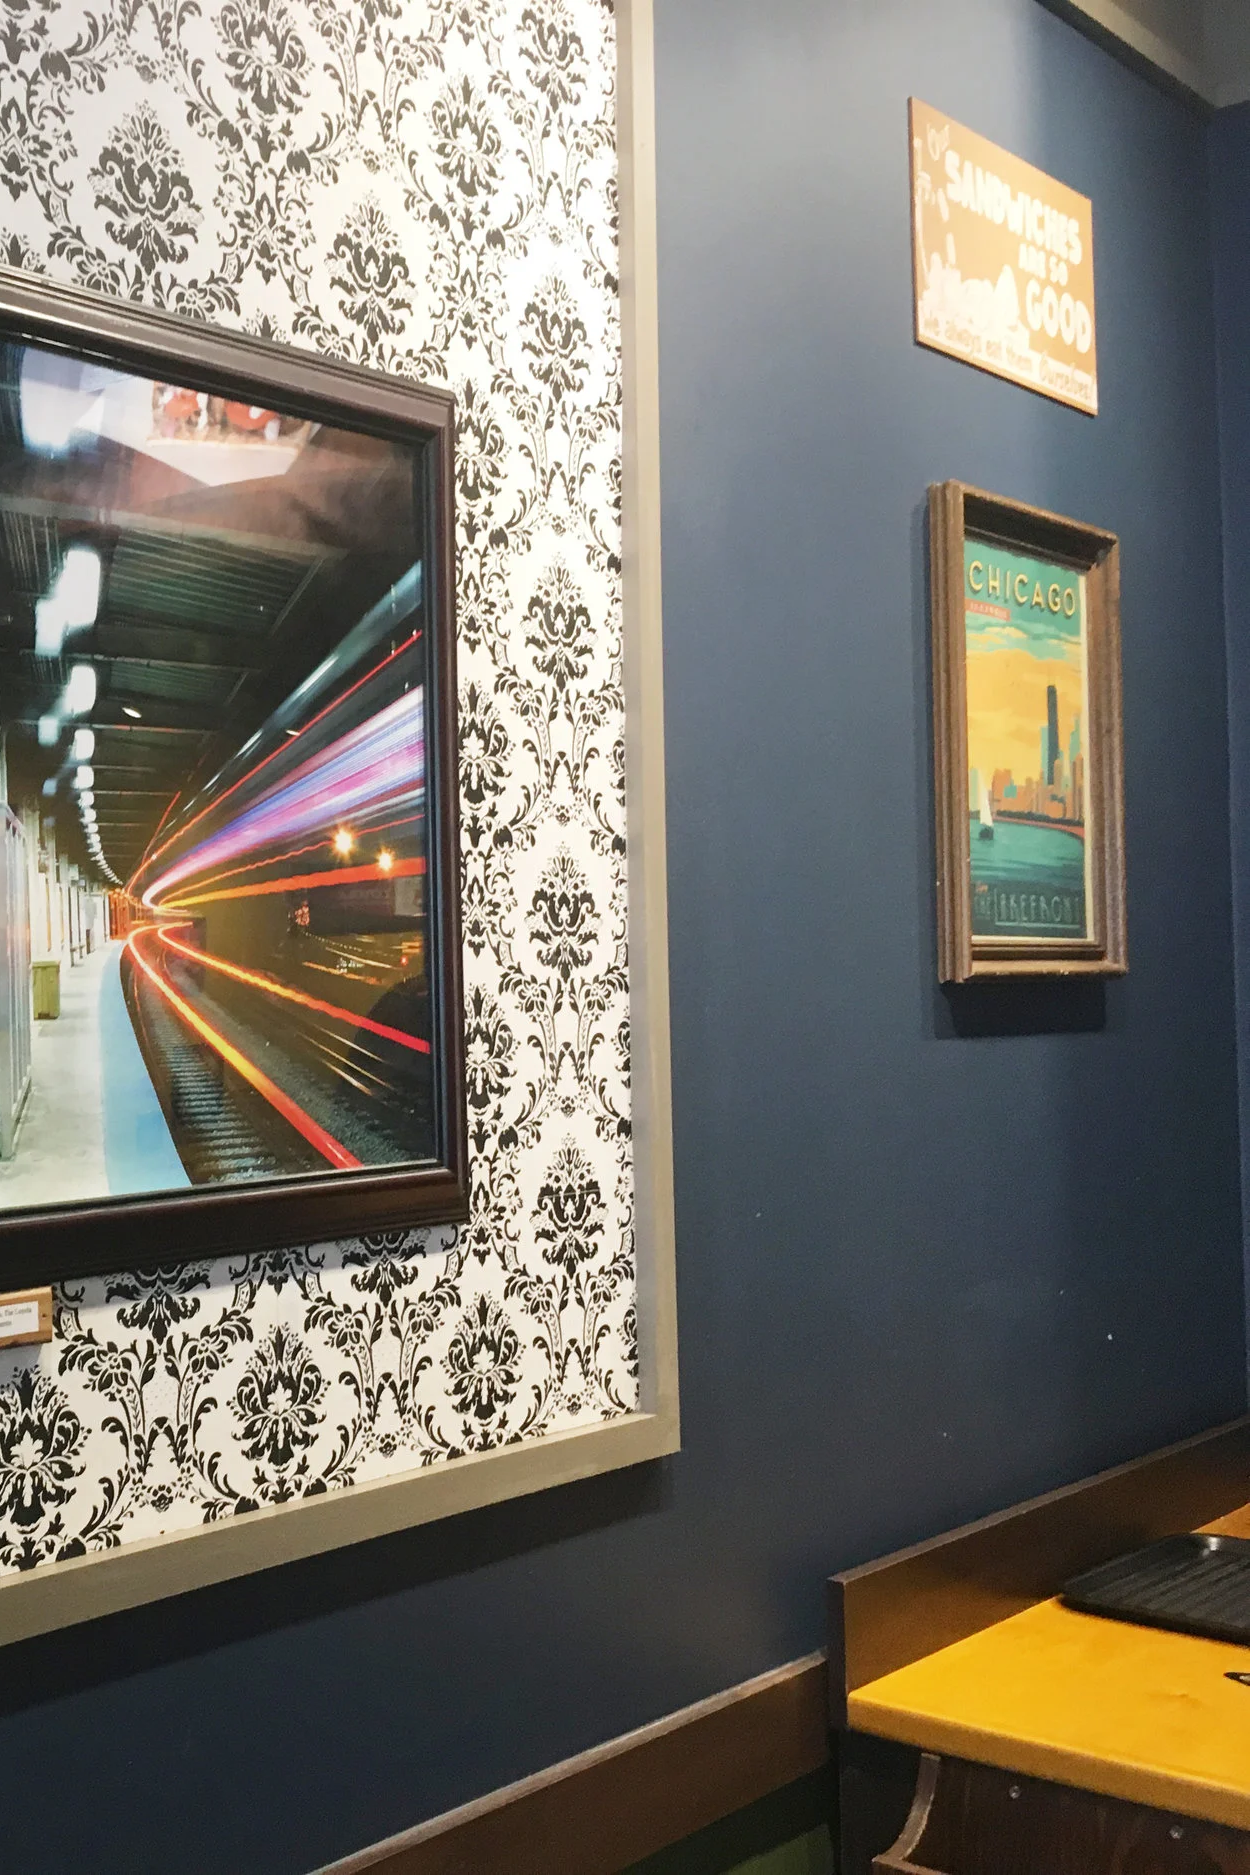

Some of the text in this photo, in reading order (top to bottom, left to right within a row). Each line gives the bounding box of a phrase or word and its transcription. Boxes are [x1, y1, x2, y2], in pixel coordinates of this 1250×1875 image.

[945, 150, 1083, 265] SANDWICHES
[1018, 243, 1069, 287] ARE SO
[1026, 278, 1092, 354] GOOD
[969, 560, 1076, 618] CHICAGO
